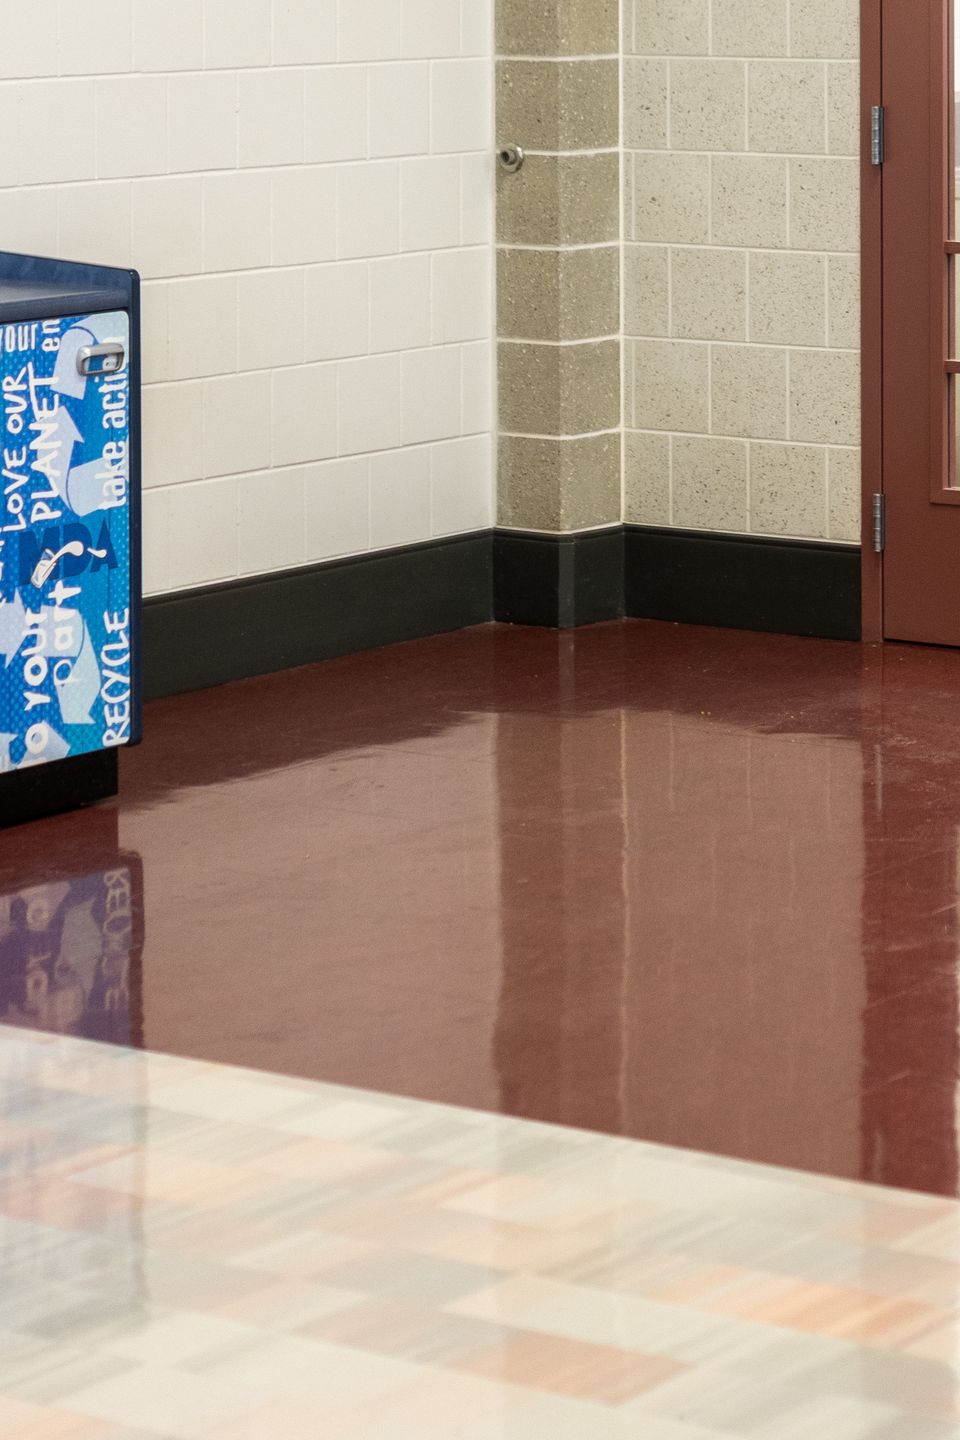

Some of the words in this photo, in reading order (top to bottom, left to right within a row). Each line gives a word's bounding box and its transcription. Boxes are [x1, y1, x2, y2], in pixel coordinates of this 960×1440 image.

[2, 366, 30, 435] OUR
[27, 361, 63, 524] PLANET
[1, 445, 30, 533] LOVE
[94, 441, 127, 511] take
[100, 607, 130, 747] RECYCLE
